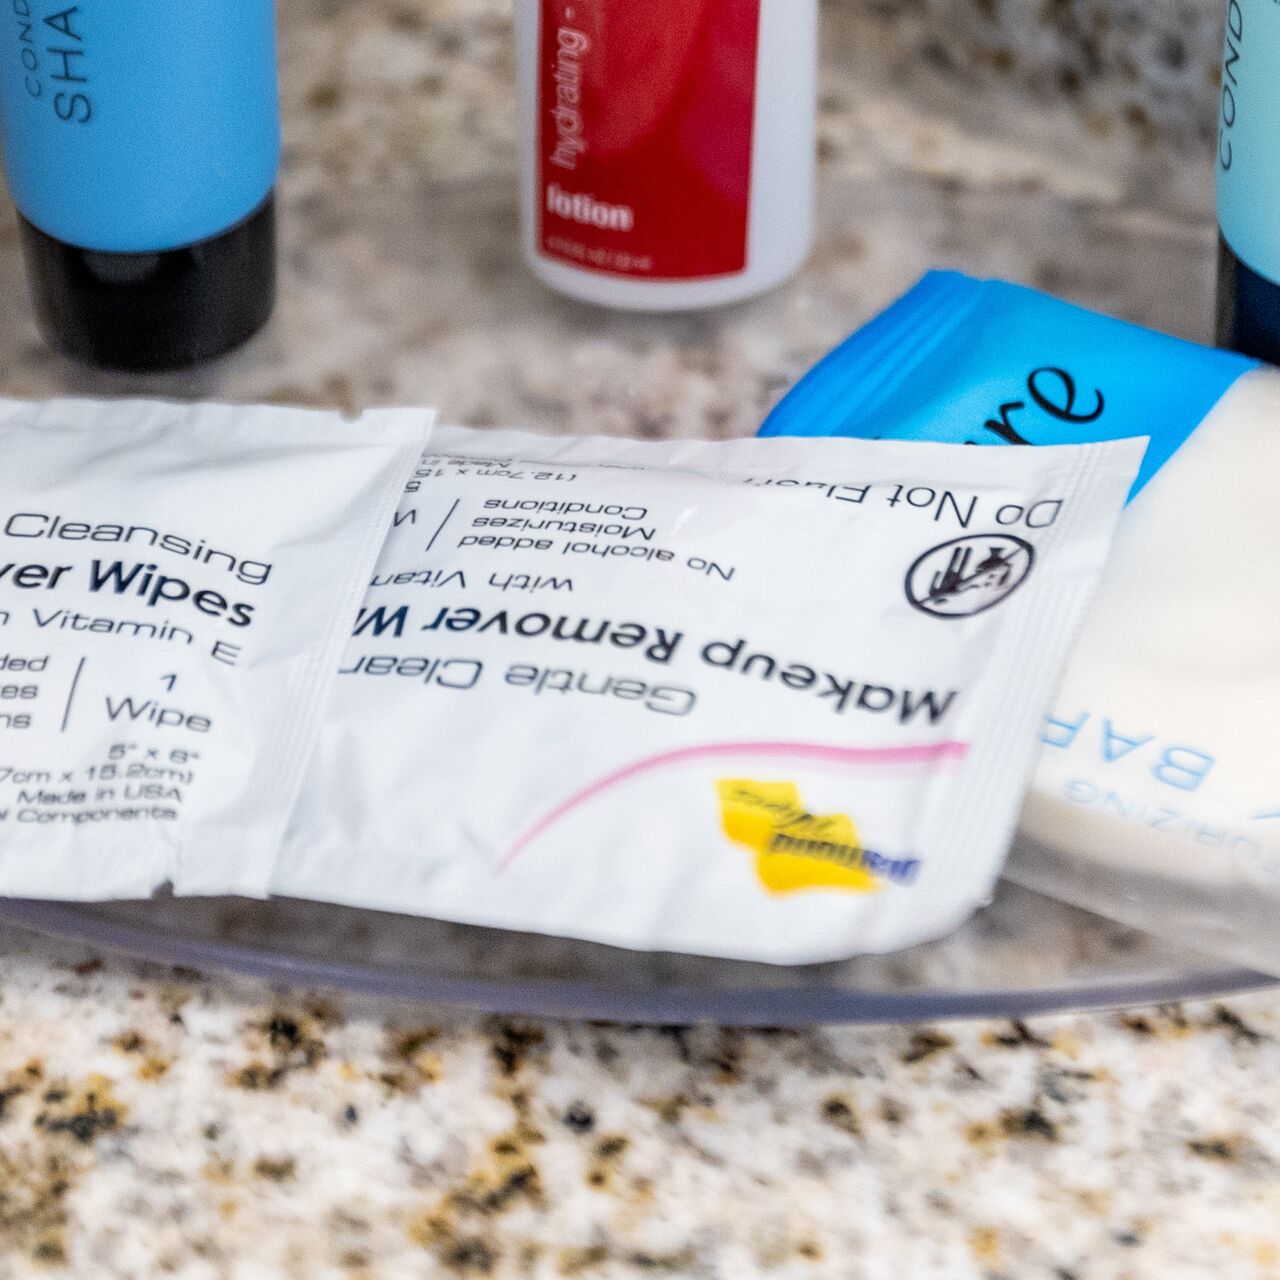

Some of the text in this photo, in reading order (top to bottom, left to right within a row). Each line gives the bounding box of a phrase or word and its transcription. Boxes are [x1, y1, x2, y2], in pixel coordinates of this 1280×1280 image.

[549, 27, 589, 169] hydrating
[546, 183, 634, 232] lotion
[471, 516, 656, 541] Moisturizes
[483, 499, 648, 520] Conditions
[886, 484, 978, 529] Not
[995, 497, 1064, 529] Do
[4, 512, 272, 586] Cleansing
[457, 534, 735, 581] No alcohol added
[89, 559, 256, 628] Wipes
[488, 570, 573, 592] with
[32, 606, 194, 646] Vitamin
[209, 640, 242, 666] E
[421, 606, 685, 664] Remover
[505, 662, 697, 717] Gentle
[701, 640, 960, 726] Makeup
[105, 695, 212, 733] Wipe
[17, 787, 87, 805] Made
[17, 805, 179, 825] Components
